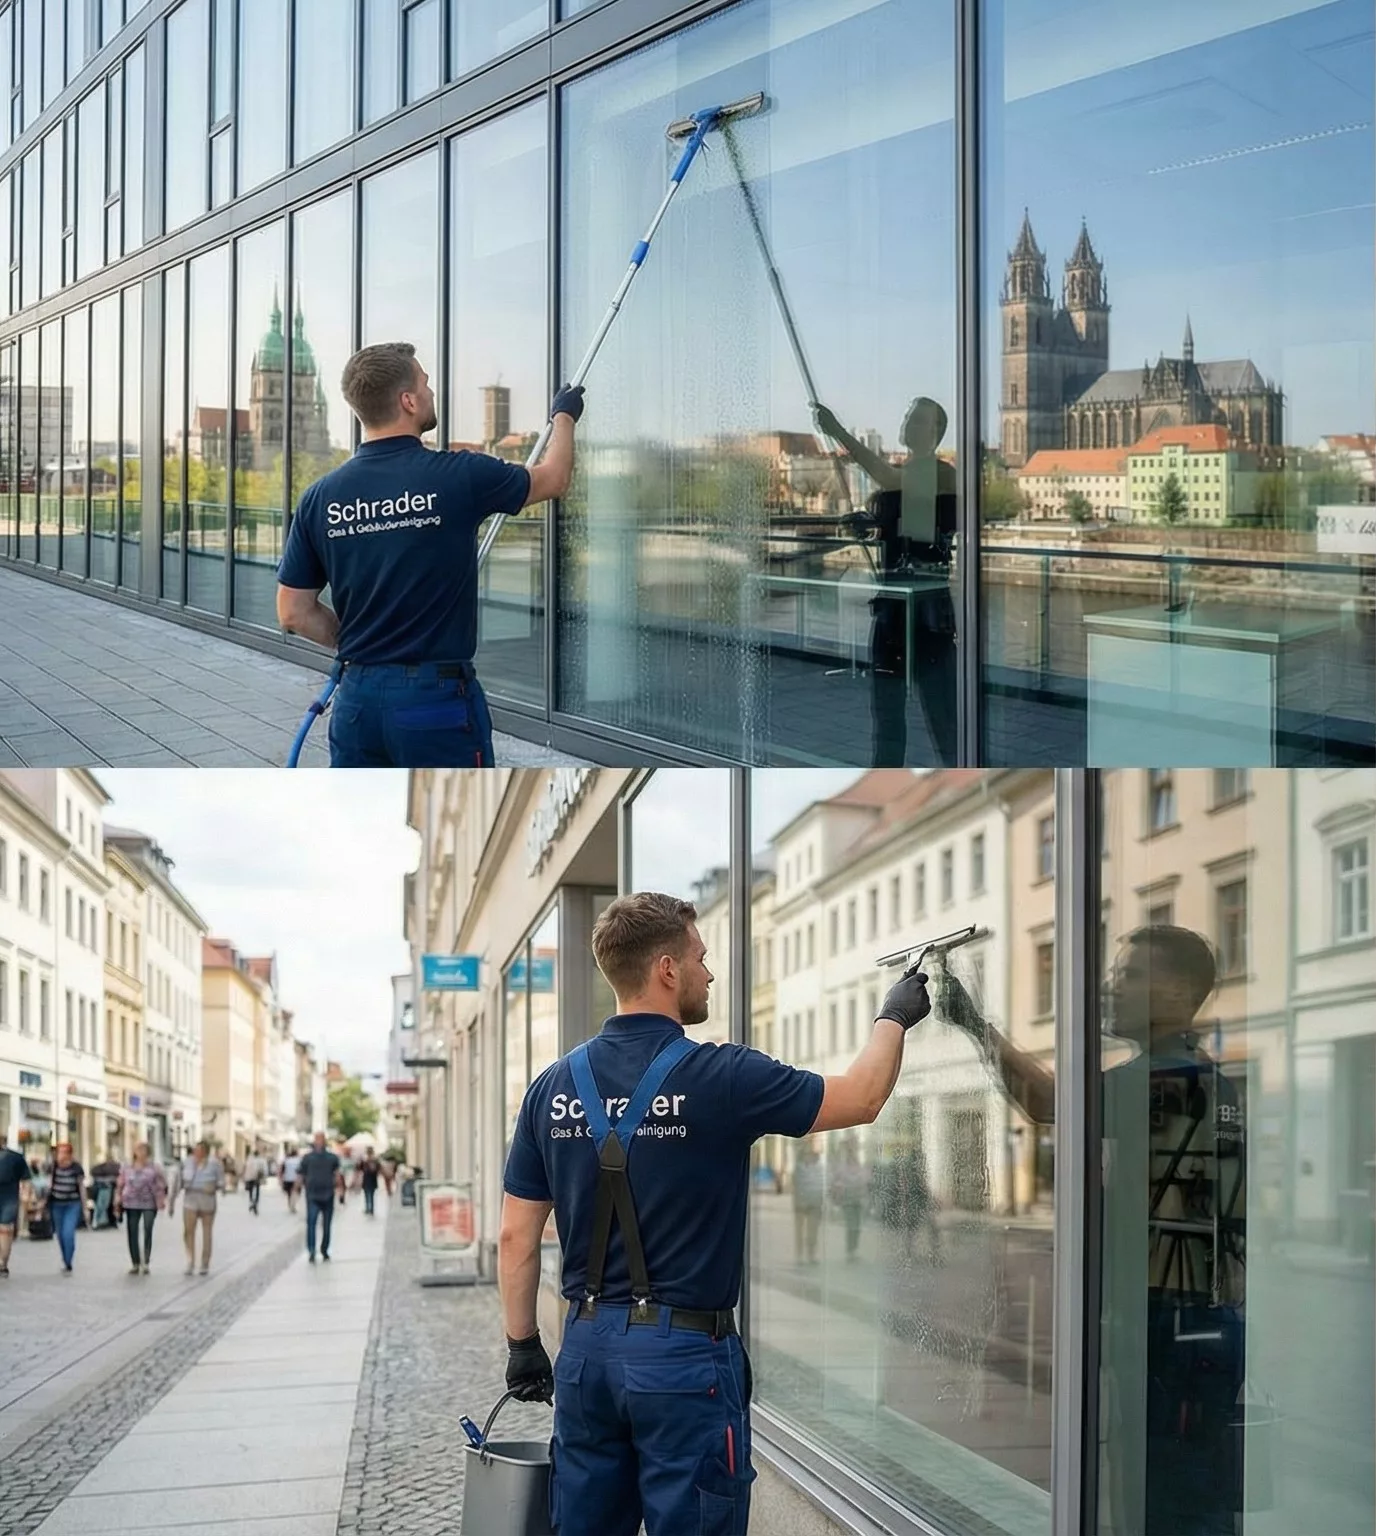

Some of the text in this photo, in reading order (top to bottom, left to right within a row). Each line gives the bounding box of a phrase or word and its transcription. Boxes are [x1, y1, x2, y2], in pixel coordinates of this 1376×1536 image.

[327, 491, 437, 525] Schrader
[550, 1093, 686, 1121] Scraer
[574, 1125, 583, 1137] &
